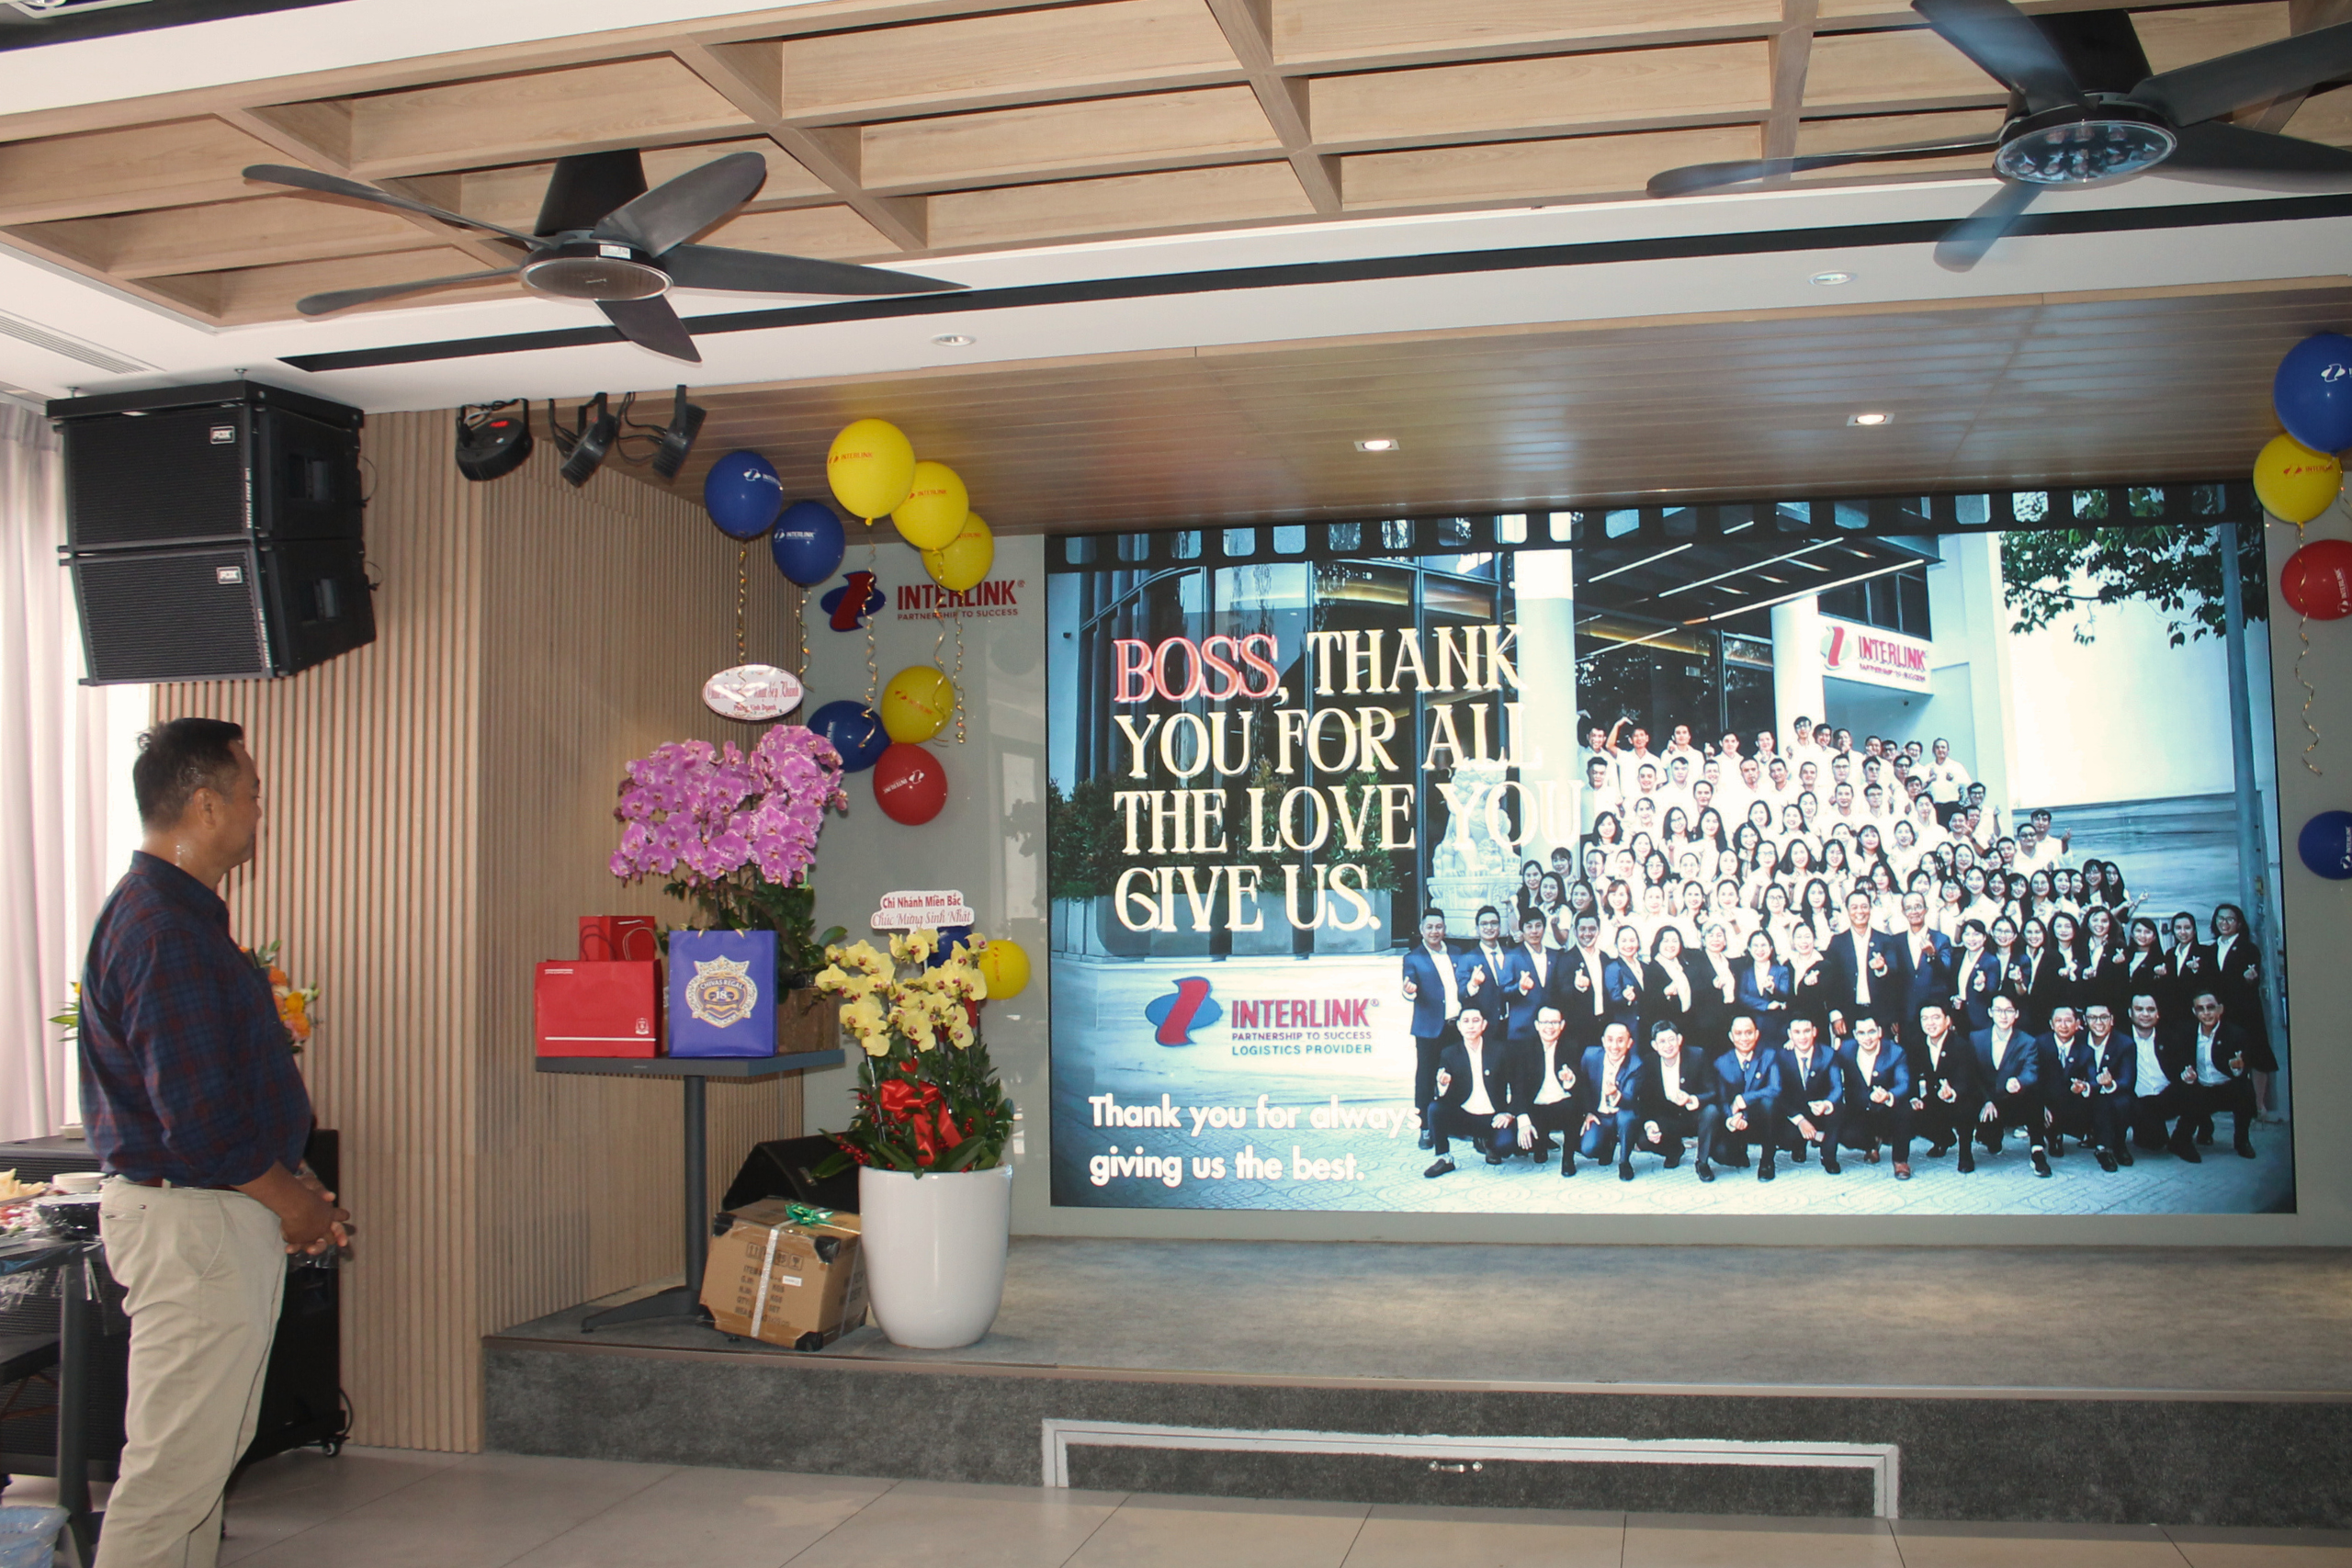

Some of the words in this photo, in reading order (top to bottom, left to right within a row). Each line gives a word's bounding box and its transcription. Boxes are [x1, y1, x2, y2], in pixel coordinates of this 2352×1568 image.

[786, 530, 816, 540] INTERLINK
[962, 610, 974, 618] TO
[976, 607, 1019, 617] SUCCESS
[1858, 635, 1927, 672] INTERLINK
[1113, 633, 1290, 707] BOSS,
[1306, 624, 1529, 695] THANK
[1113, 709, 1254, 779] YOU
[1273, 706, 1400, 775] FOR
[1421, 702, 1544, 772] ALL
[1113, 787, 1228, 855] THE
[1245, 784, 1417, 853] LOVE
[1434, 779, 1586, 852] YOU
[882, 897, 896, 909] Chi
[897, 896, 924, 908] Nhánh
[924, 894, 945, 908] Miền
[946, 892, 962, 907] Bắc
[1114, 864, 1264, 933] GIVE
[1281, 862, 1382, 932] US.
[872, 912, 895, 927] Chúc
[924, 908, 946, 925] Sinh
[699, 979, 723, 989] CHIVAS
[723, 979, 745, 990] REGAL
[716, 990, 728, 1000] 18
[1231, 1032, 1303, 1042] PARTNERSHIP
[1306, 1032, 1321, 1041] TO
[1324, 1031, 1373, 1041] SUCCESS
[1231, 1044, 1302, 1056] LOGISTICS
[1306, 1043, 1373, 1055] PROVIDER
[1088, 1092, 1182, 1128] Thank
[1188, 1106, 1248, 1138] you
[1256, 1093, 1303, 1130] for
[1308, 1094, 1423, 1140] always
[1089, 1145, 1183, 1189] giving
[1192, 1156, 1227, 1180] us
[1234, 1145, 1283, 1181] the
[1292, 1145, 1366, 1181] best.
